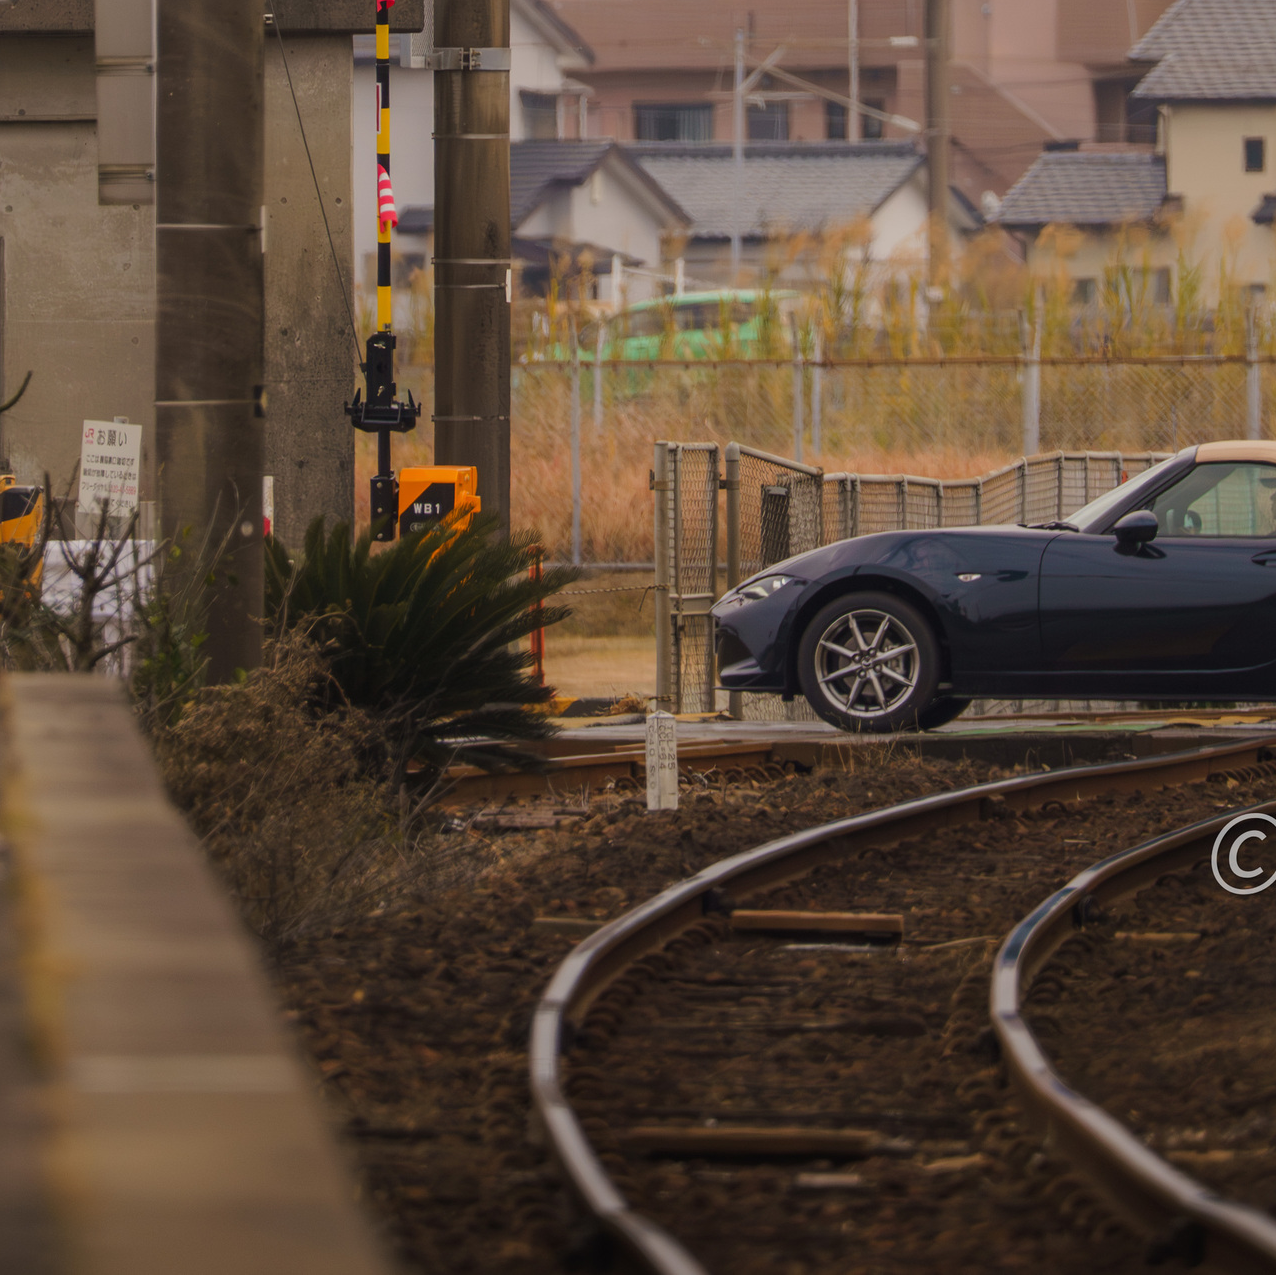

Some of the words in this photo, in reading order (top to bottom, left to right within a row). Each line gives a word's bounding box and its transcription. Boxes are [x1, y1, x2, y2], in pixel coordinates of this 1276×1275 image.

[96, 429, 128, 447] お願い
[413, 503, 440, 514] WB1
